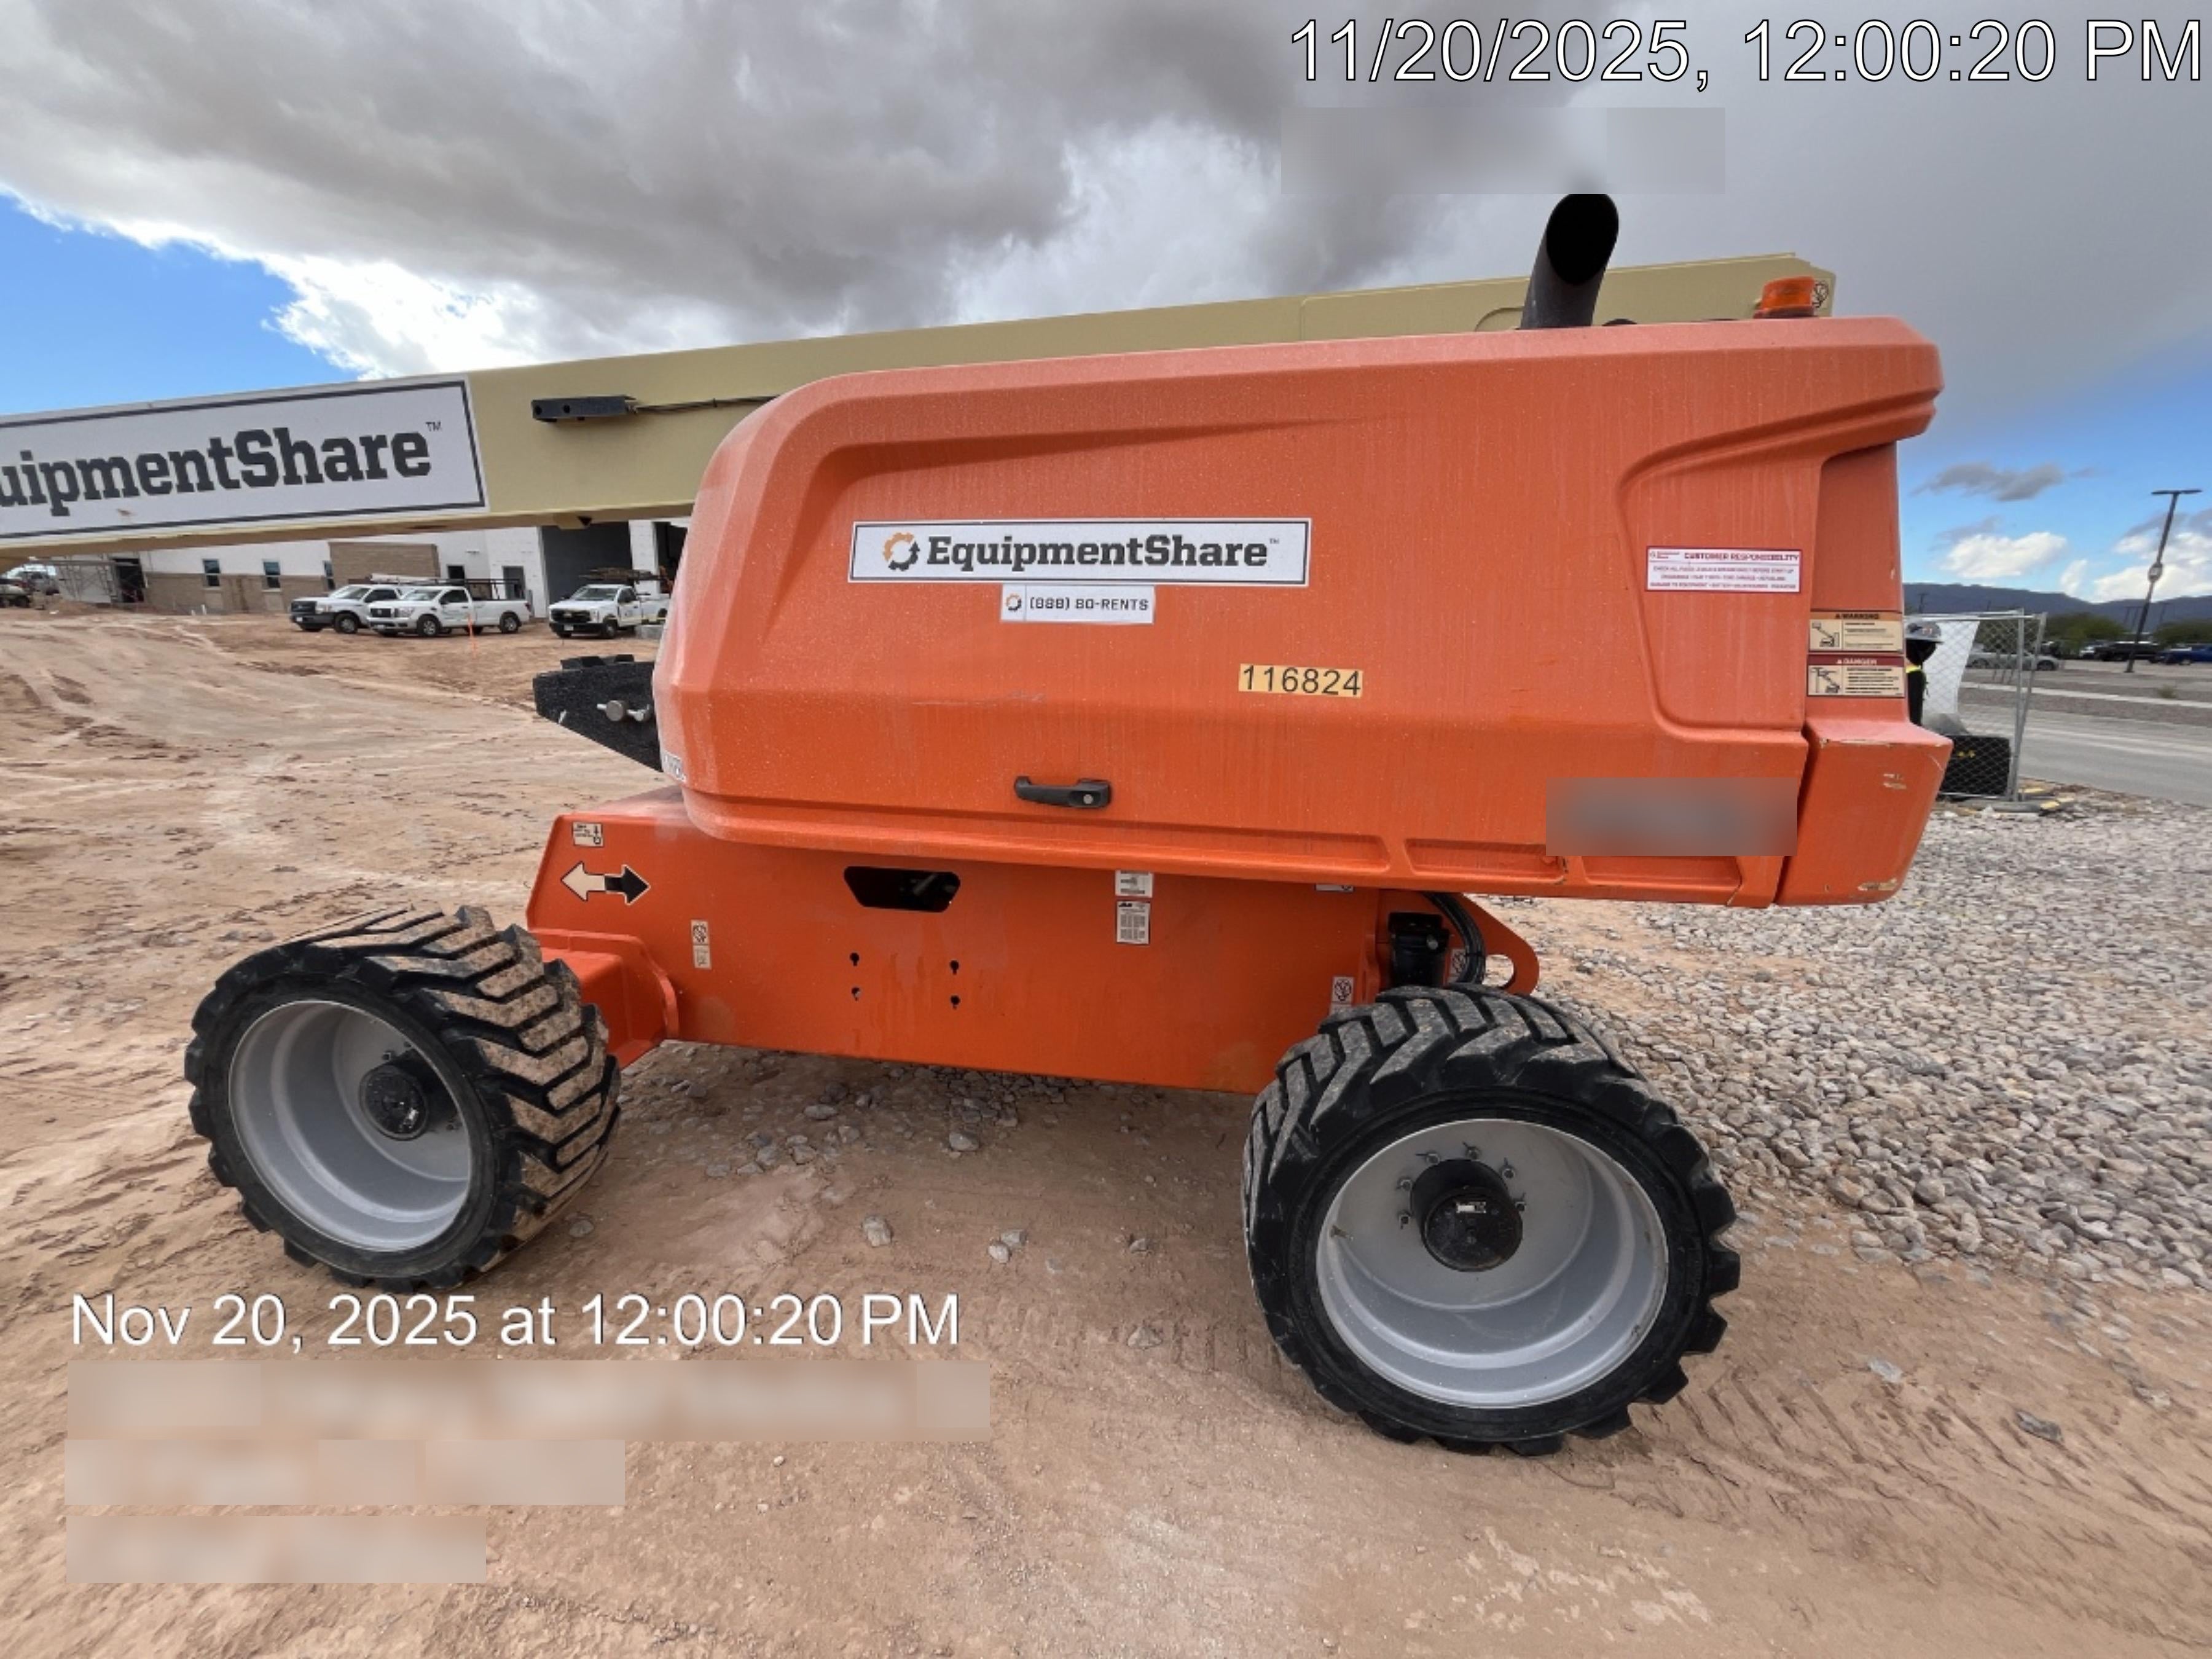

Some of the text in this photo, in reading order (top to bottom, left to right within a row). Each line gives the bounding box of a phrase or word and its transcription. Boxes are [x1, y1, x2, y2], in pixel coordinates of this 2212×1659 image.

[927, 535, 1268, 571] EquipmentShare
[1030, 597, 1070, 611] (888)
[1244, 665, 1361, 696] 116824
